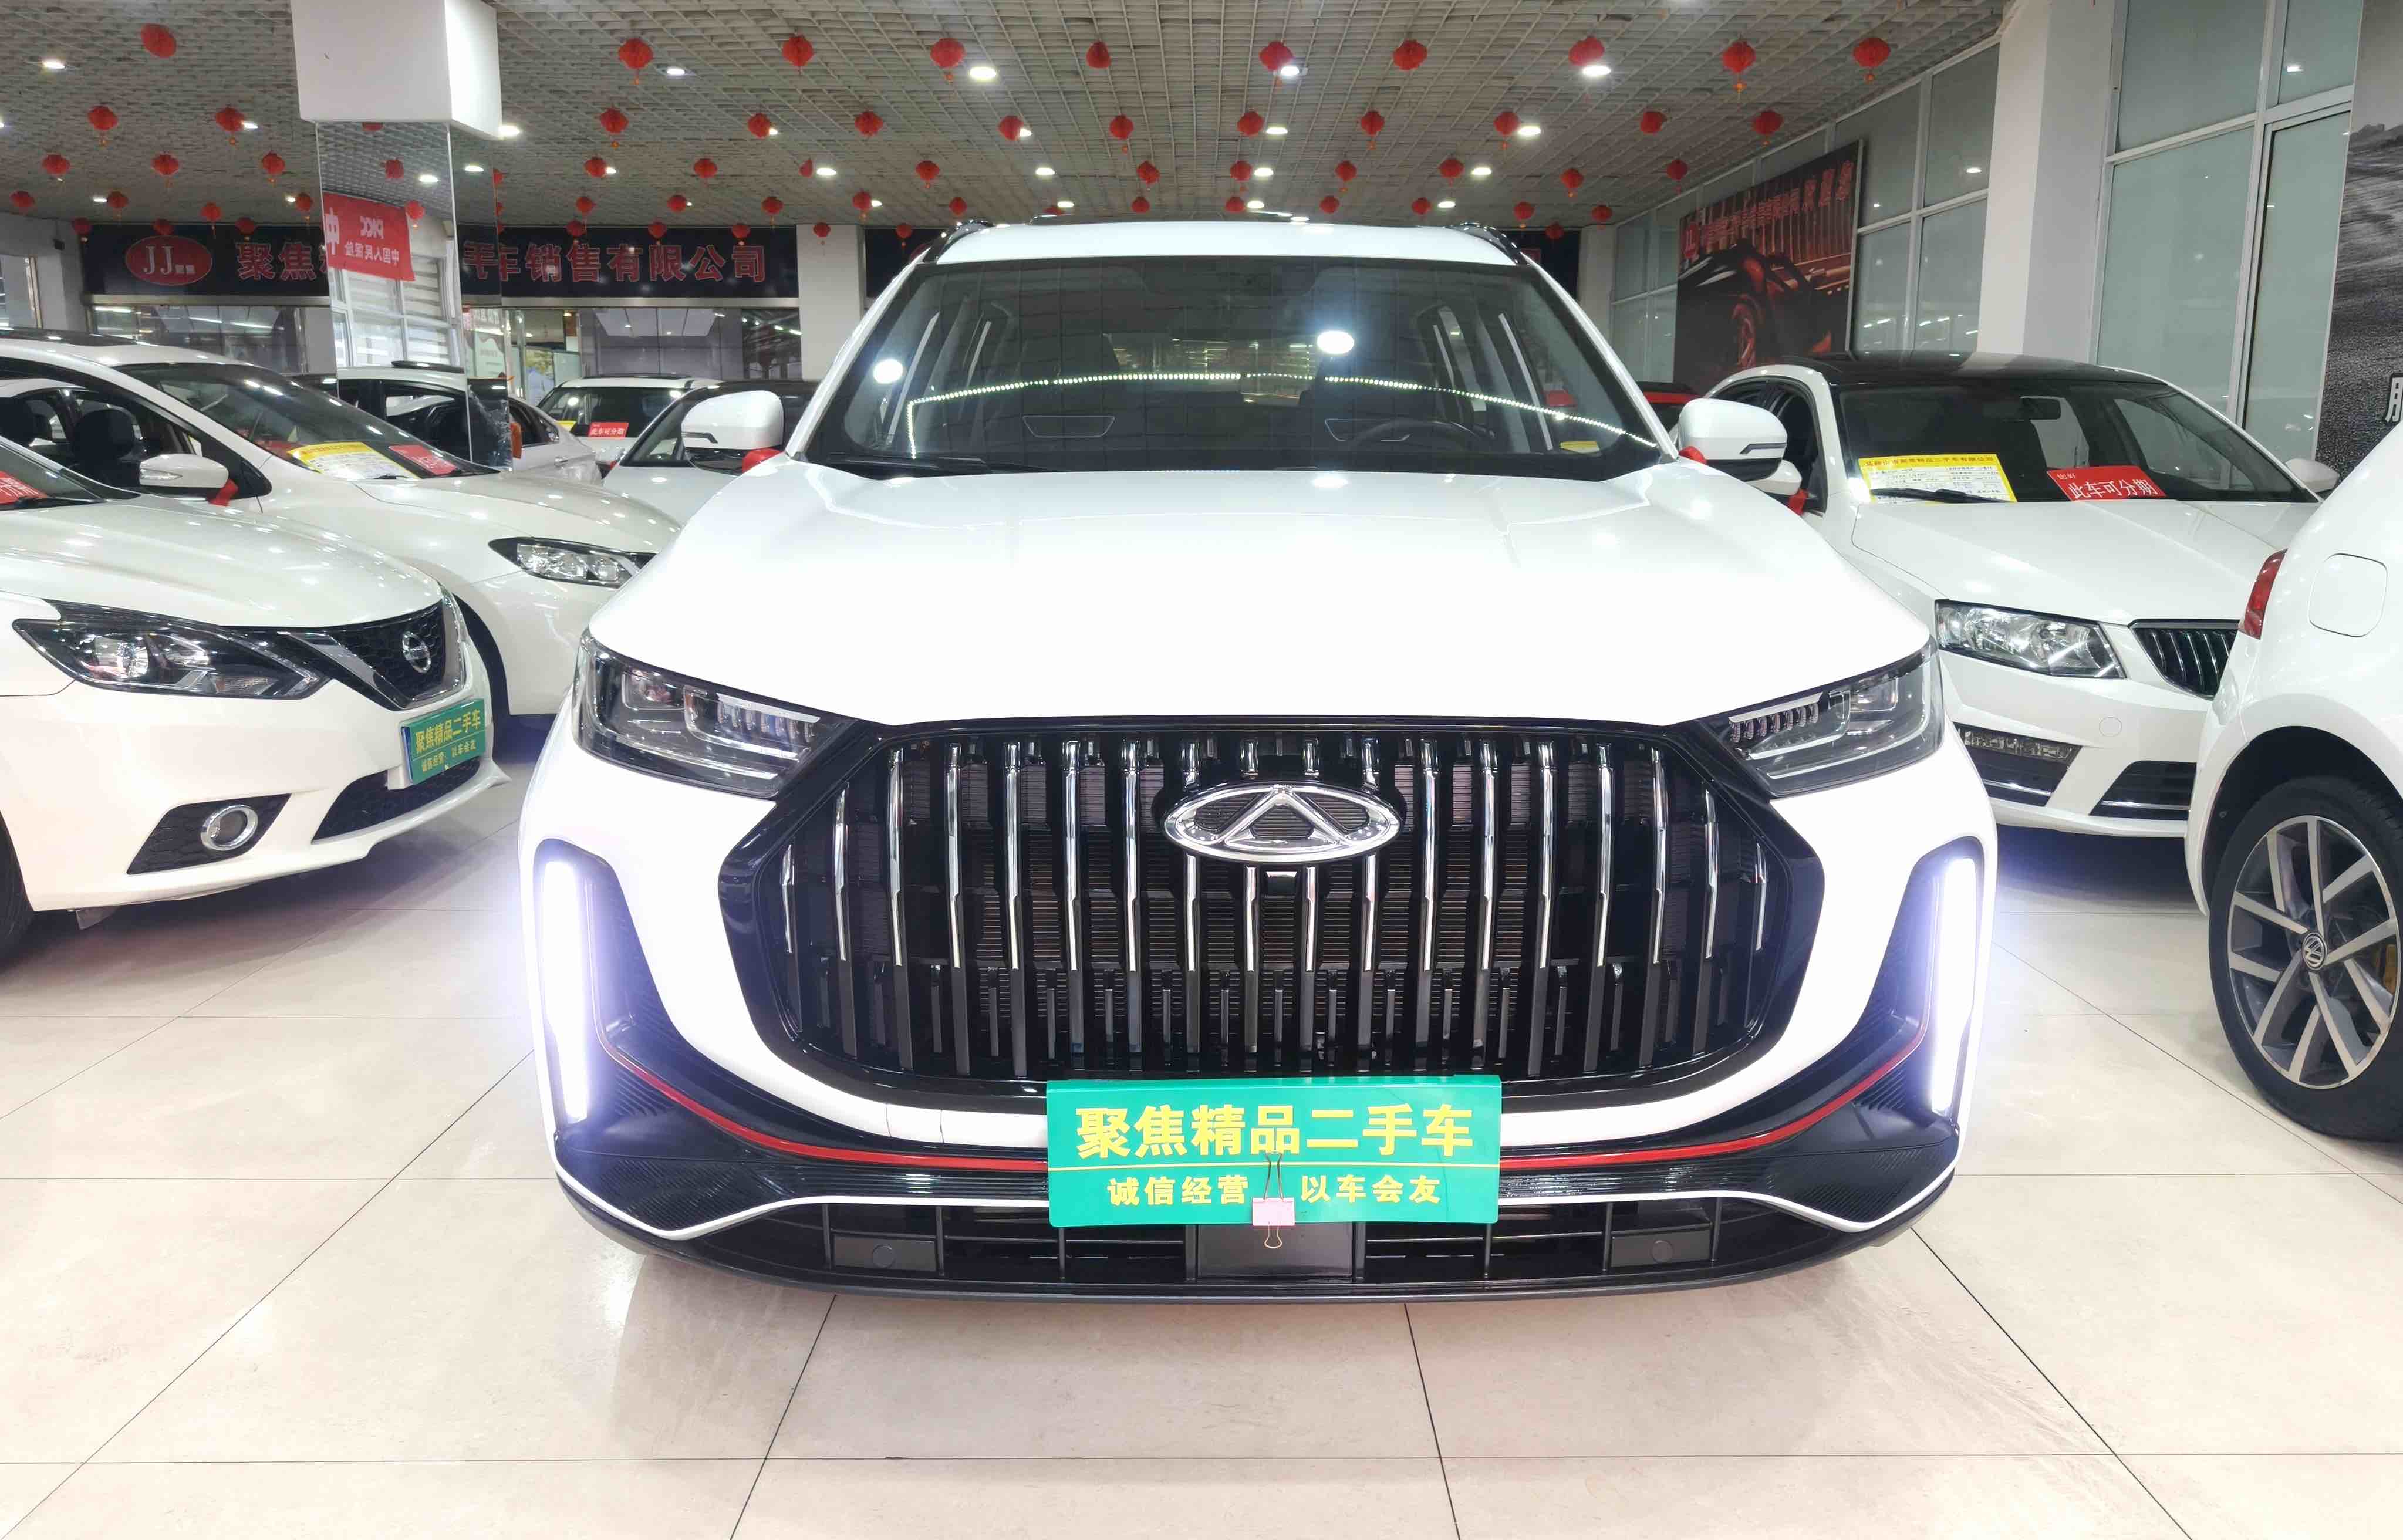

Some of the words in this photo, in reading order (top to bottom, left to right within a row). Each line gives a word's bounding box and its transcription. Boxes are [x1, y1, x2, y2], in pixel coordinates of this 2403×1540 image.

[143, 245, 175, 275] JJ
[235, 241, 327, 281] 聚焦
[2068, 479, 2158, 499] 此车可分期
[1075, 1104, 1474, 1159] 聚焦精品二手车
[1106, 1175, 1249, 1206] 诚信经营
[1300, 1174, 1441, 1204] 以车会友
